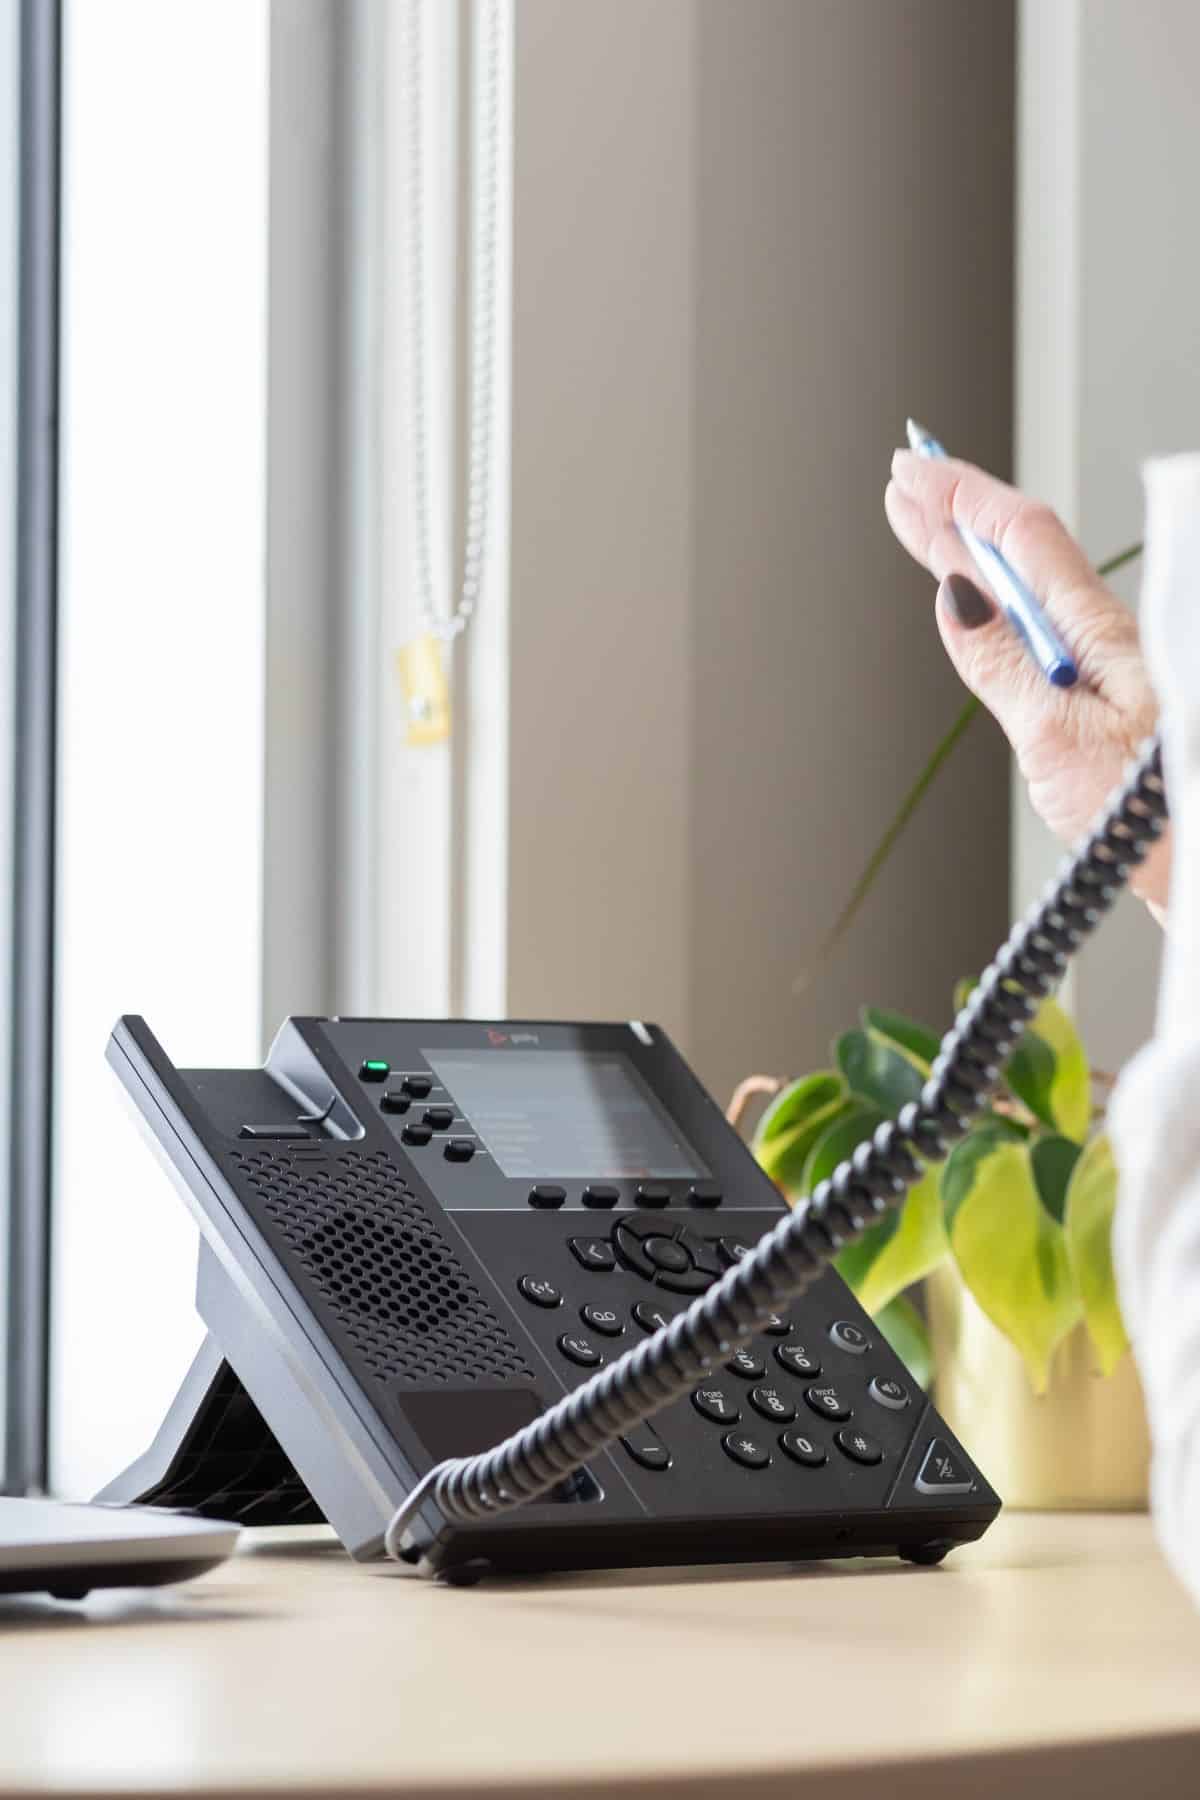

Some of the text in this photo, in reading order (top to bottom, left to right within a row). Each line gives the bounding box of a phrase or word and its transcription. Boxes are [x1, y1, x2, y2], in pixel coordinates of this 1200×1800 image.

[738, 1354, 754, 1368] 5
[794, 1353, 811, 1368] 6
[710, 1399, 725, 1413] 7
[767, 1397, 785, 1412] 8
[823, 1396, 839, 1410] 9
[796, 1437, 813, 1453] 0
